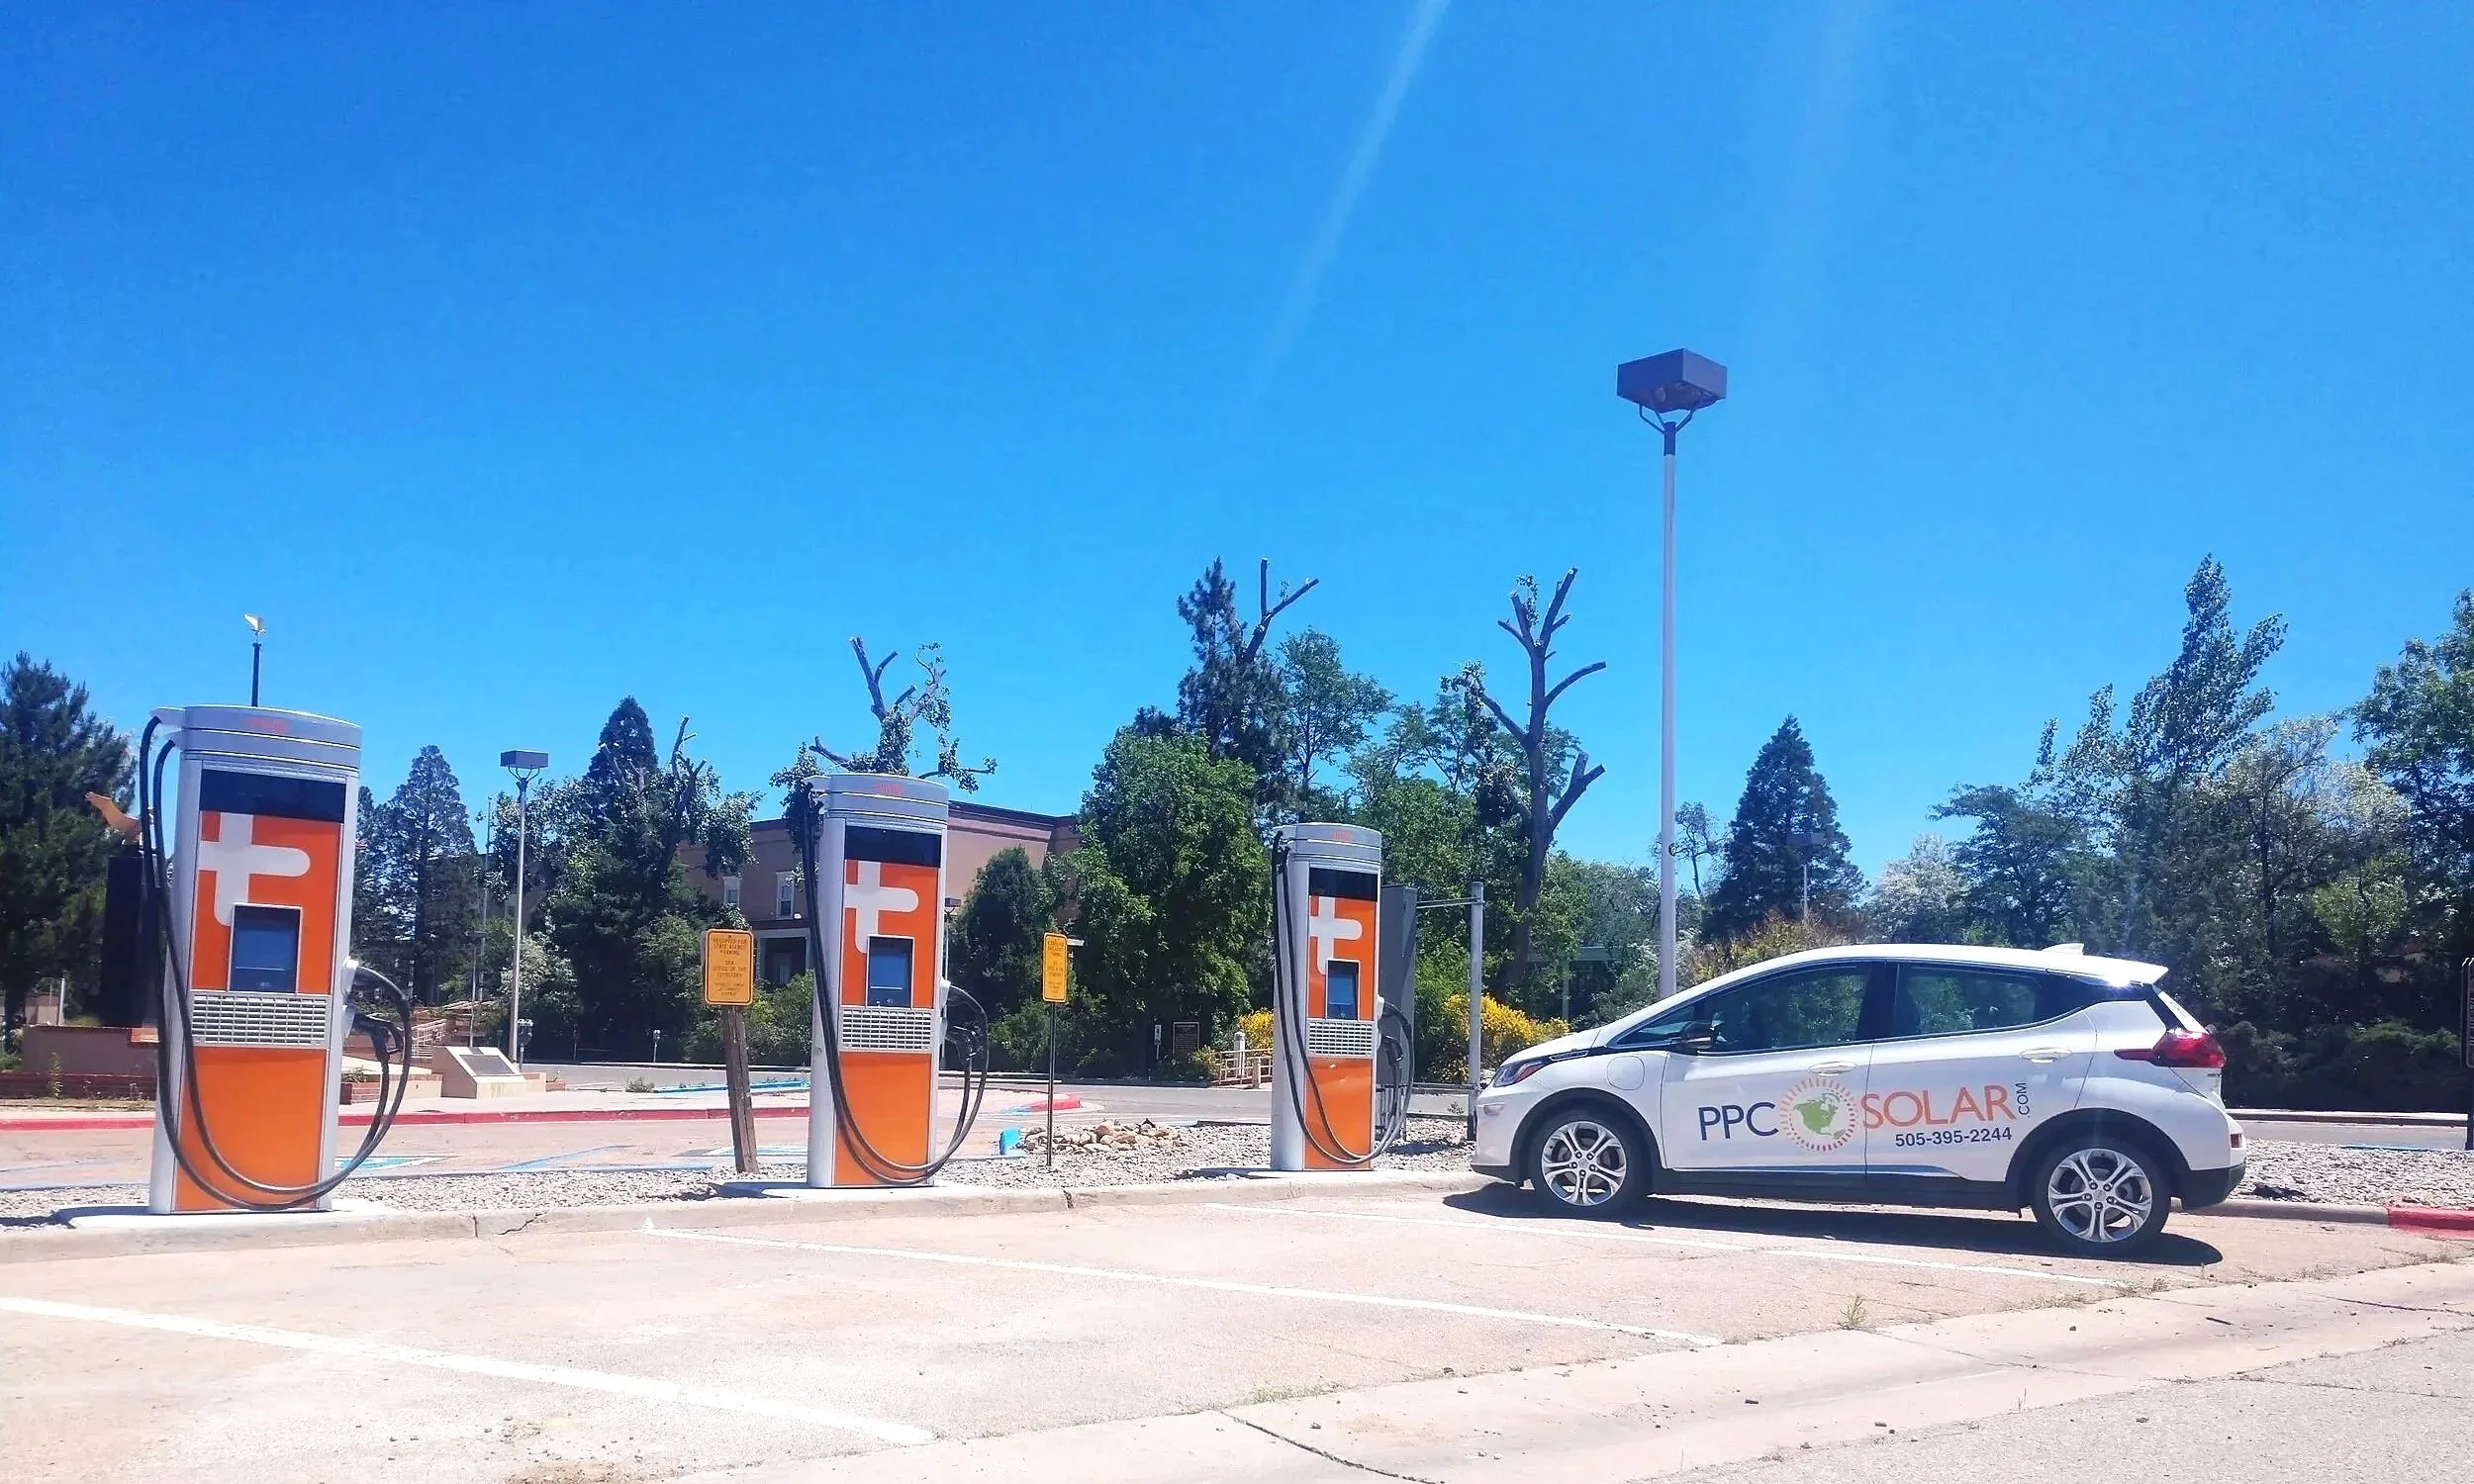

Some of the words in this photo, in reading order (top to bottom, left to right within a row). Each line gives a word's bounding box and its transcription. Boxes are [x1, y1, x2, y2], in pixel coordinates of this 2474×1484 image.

[1698, 1101, 1779, 1141] PPC
[1860, 1084, 2017, 1129] SOLAR
[1895, 1126, 2013, 1148] 505-395-2244
